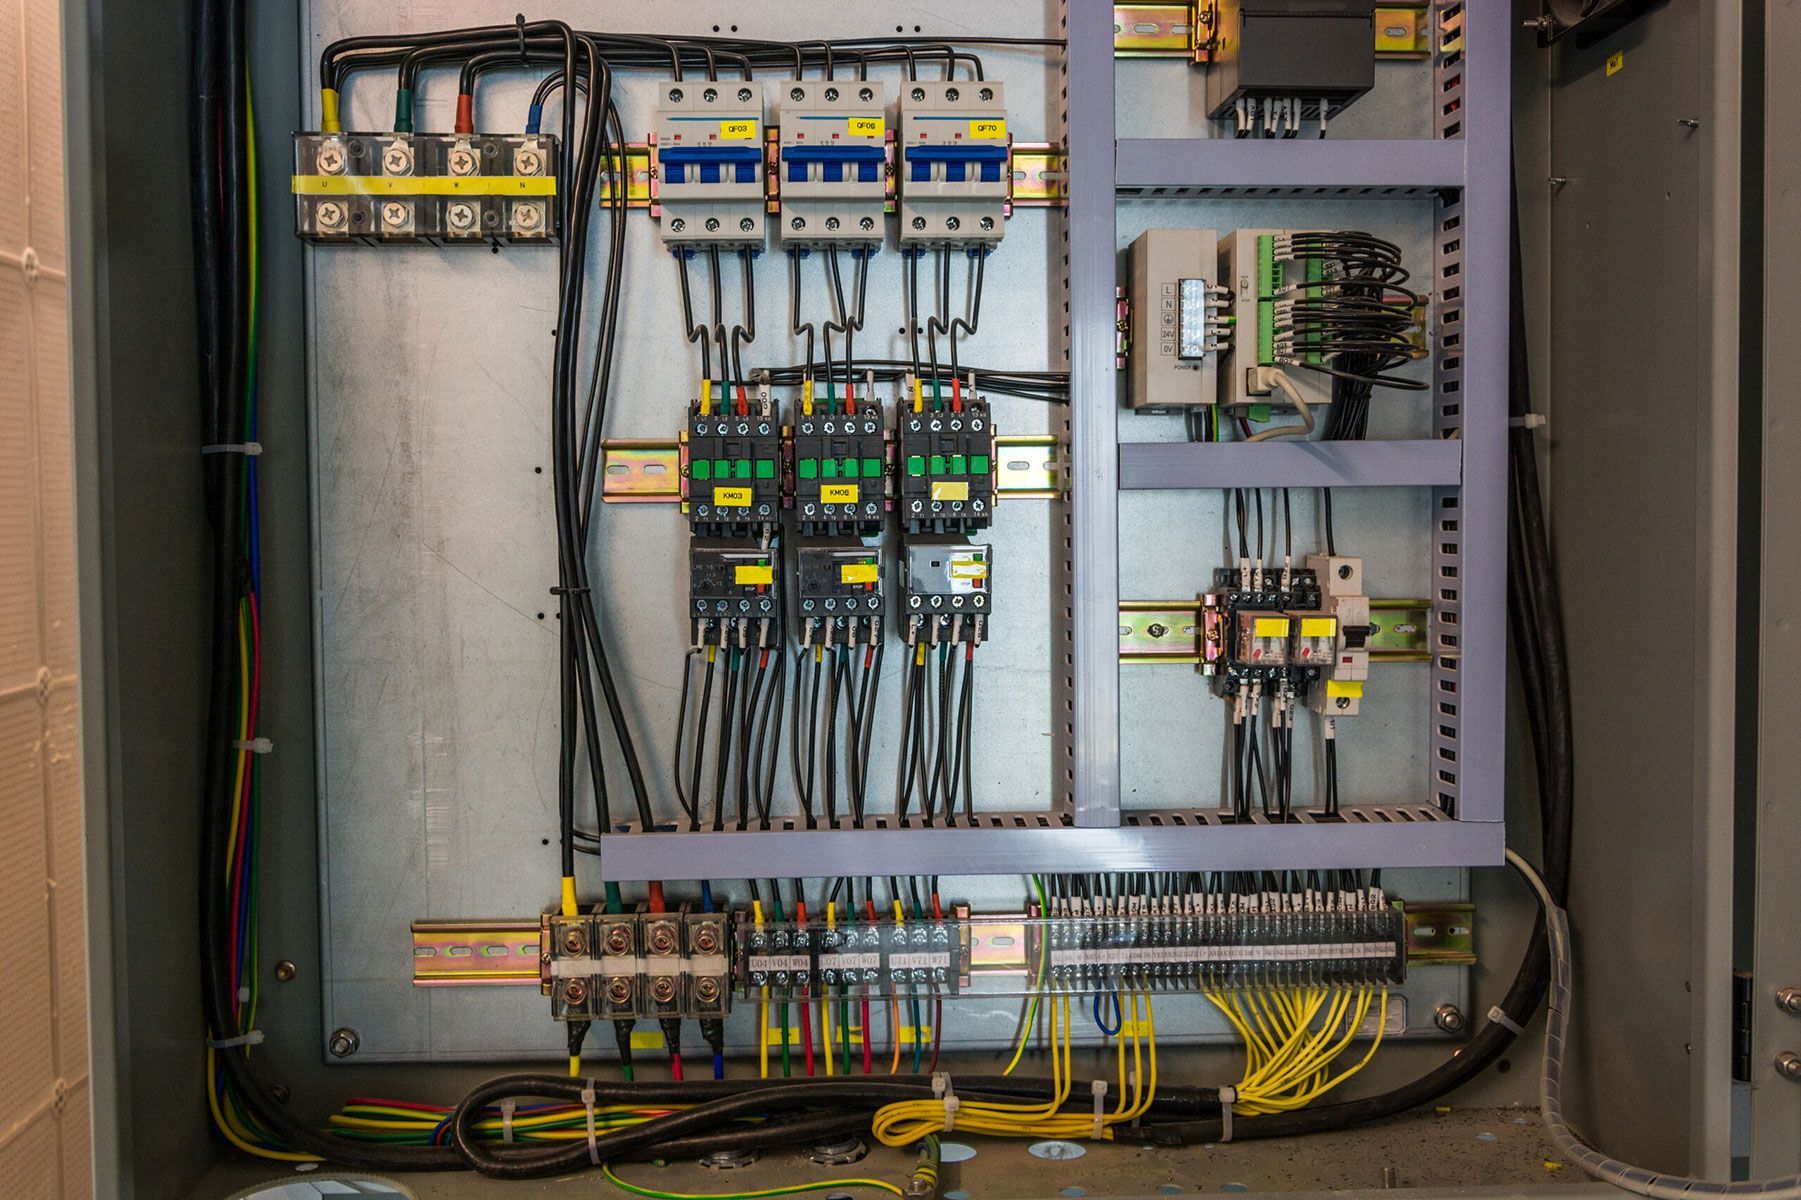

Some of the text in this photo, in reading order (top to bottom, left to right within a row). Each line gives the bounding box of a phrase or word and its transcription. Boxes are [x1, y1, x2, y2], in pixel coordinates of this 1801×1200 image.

[728, 125, 748, 133] QF03
[977, 124, 997, 132] QF70
[1166, 300, 1172, 308] N
[1162, 330, 1175, 338] 24V
[723, 492, 743, 500] KM03
[751, 959, 808, 968] U04 V04 W04
